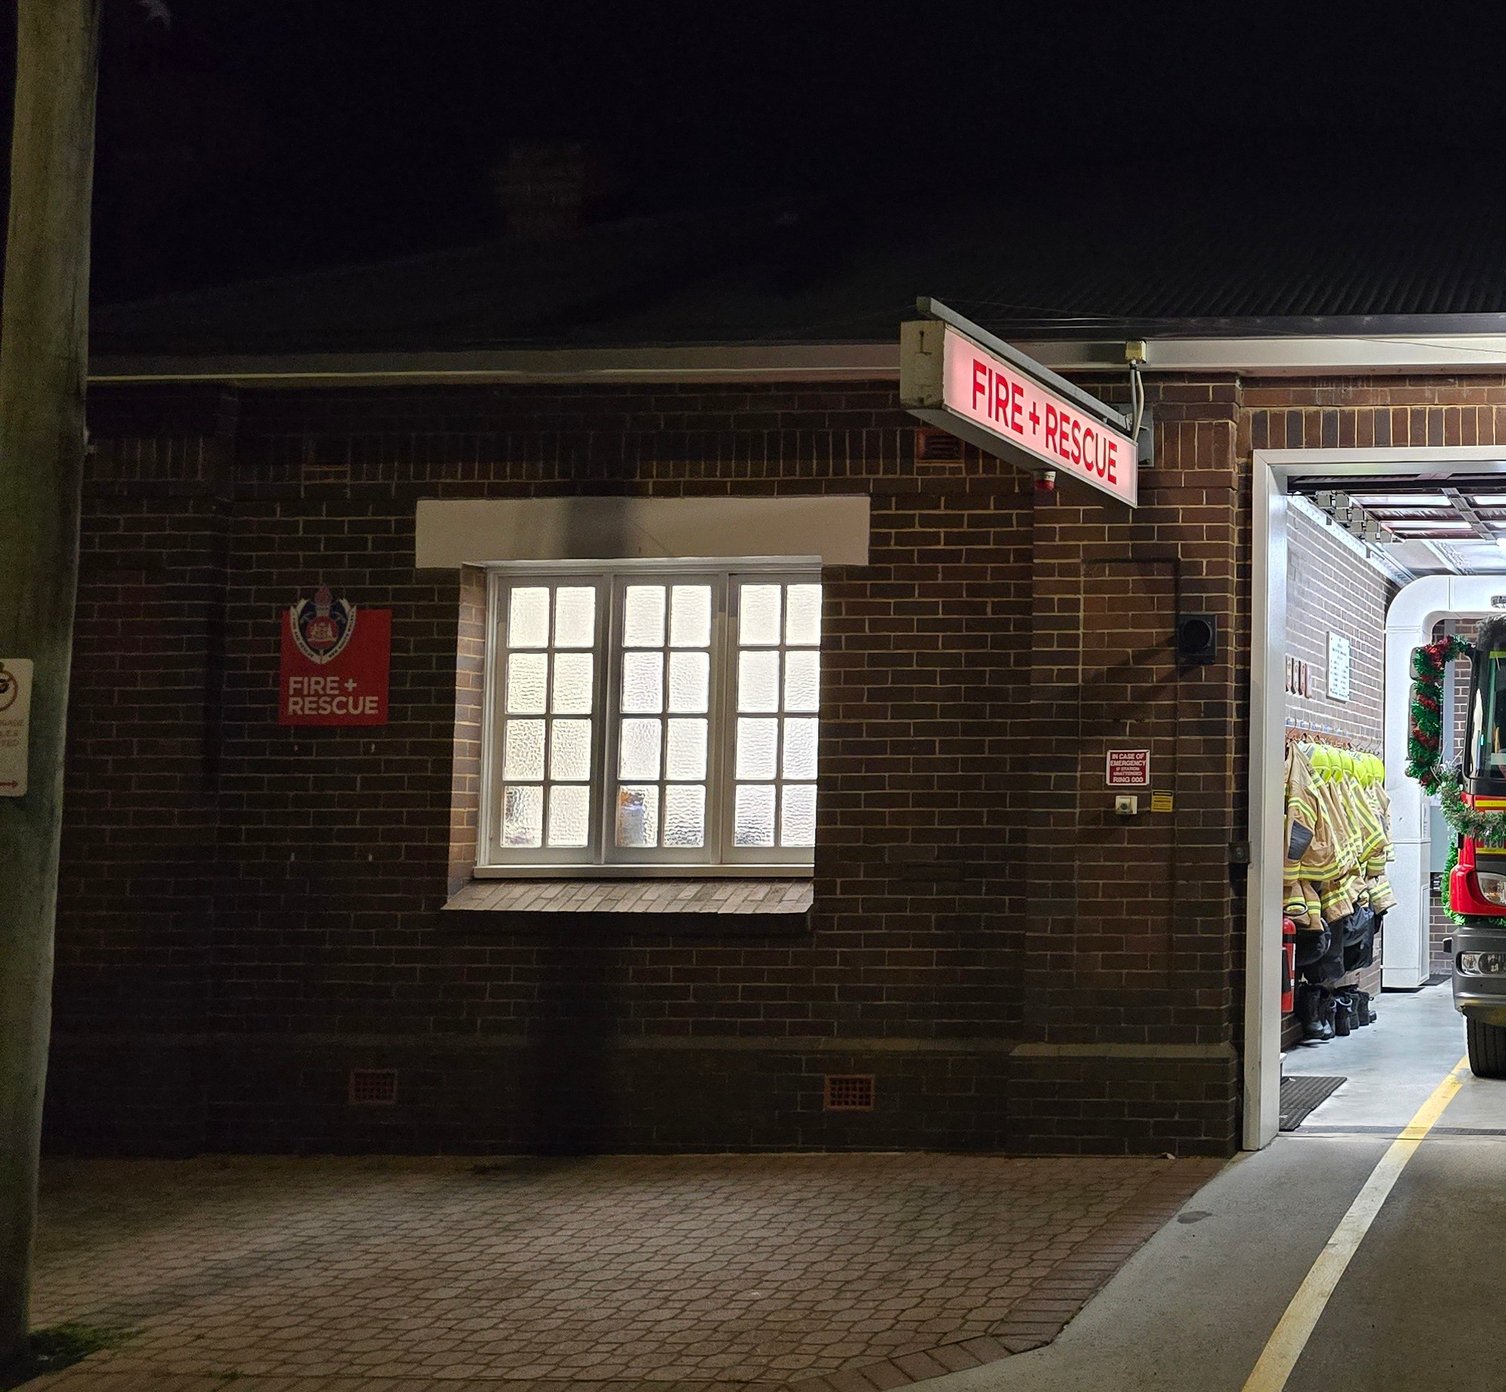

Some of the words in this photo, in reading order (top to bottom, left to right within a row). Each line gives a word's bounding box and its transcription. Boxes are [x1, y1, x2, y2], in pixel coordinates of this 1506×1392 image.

[972, 358, 1024, 435] FIRE
[1029, 401, 1040, 435] +
[1045, 402, 1118, 485] RESCUE
[289, 676, 340, 695] FIRE
[344, 678, 357, 692] +
[288, 696, 379, 715] RESCUE
